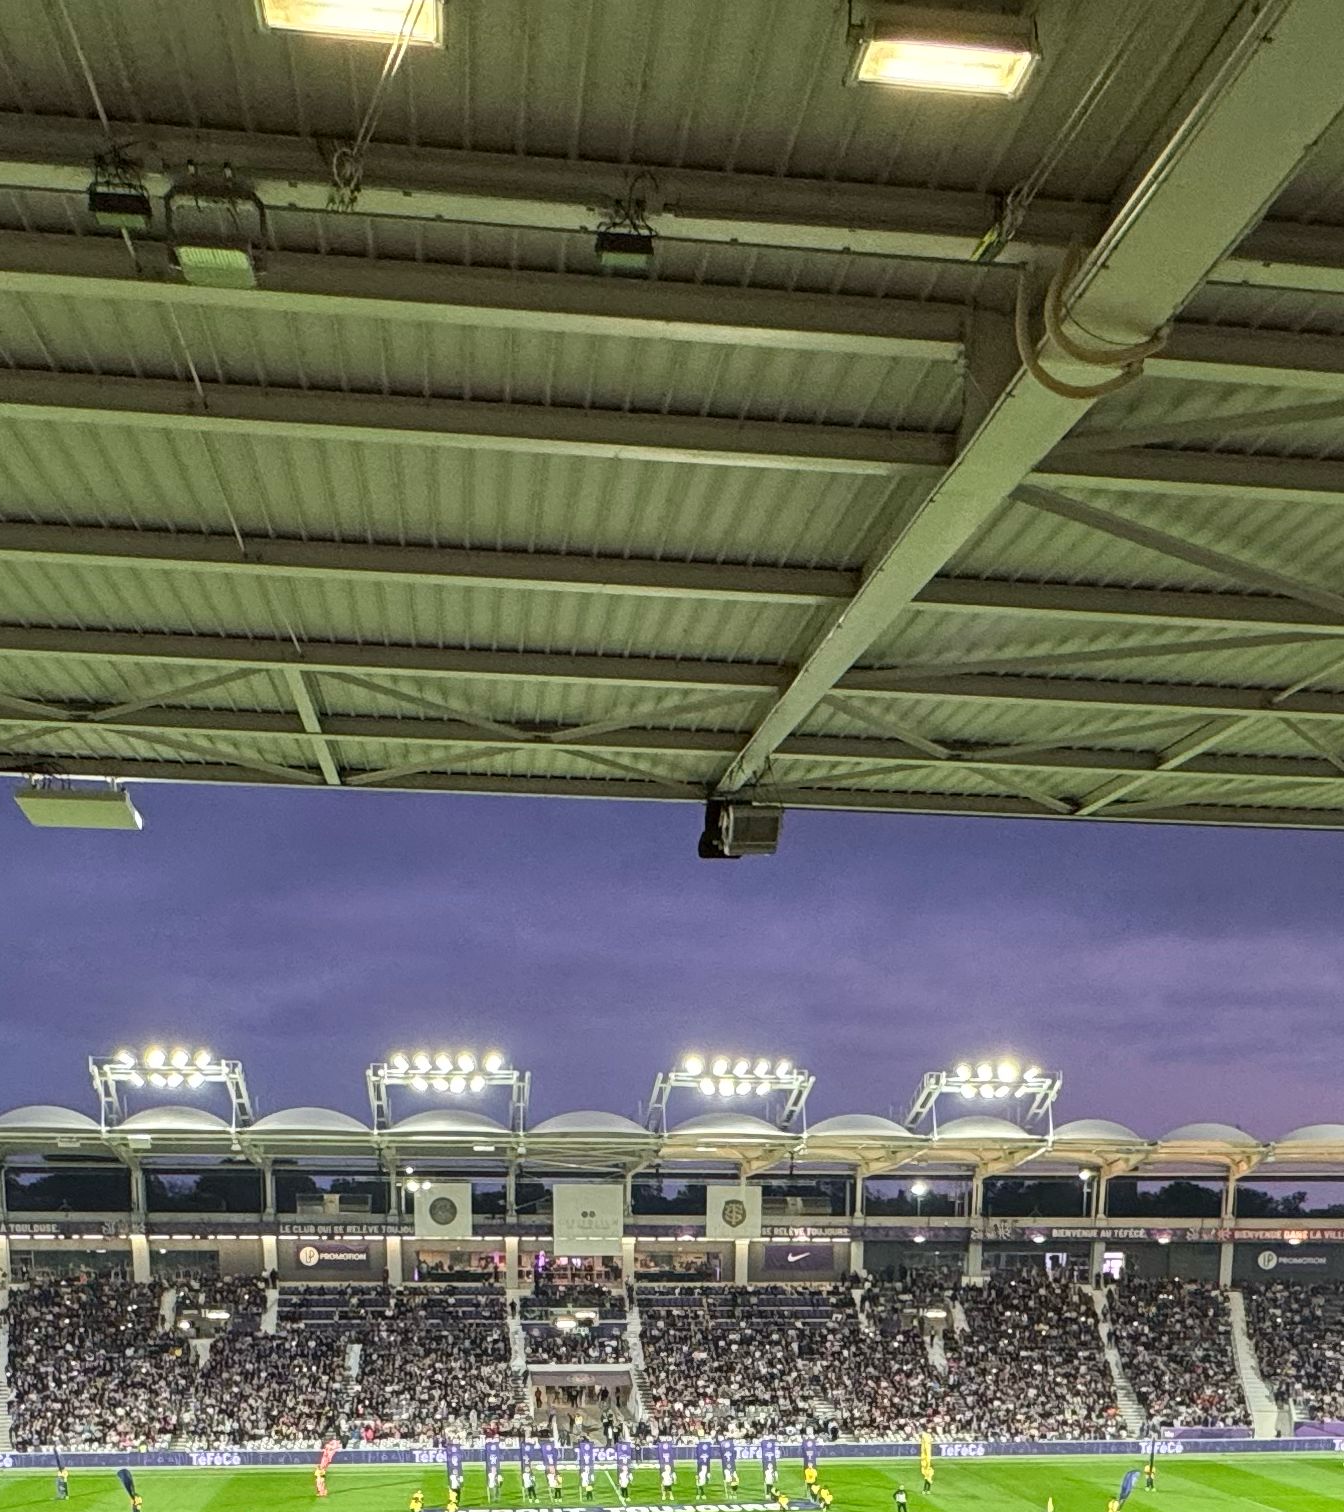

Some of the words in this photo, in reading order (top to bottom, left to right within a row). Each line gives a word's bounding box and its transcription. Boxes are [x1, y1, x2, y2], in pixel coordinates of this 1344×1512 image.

[9, 1223, 58, 1233] TOULOUSE
[280, 1225, 291, 1235] LE
[293, 1225, 315, 1235] CLUB
[317, 1225, 332, 1235] QUI
[334, 1225, 344, 1235] SE
[1052, 1228, 1097, 1238] BIENVENUE
[1099, 1228, 1111, 1238] AU
[1233, 1230, 1282, 1240] BIENVENUE
[1284, 1230, 1308, 1240] DANS
[1309, 1230, 1322, 1240] LA
[319, 1252, 367, 1261] PROMOTION
[1278, 1256, 1327, 1265] PROMOTION
